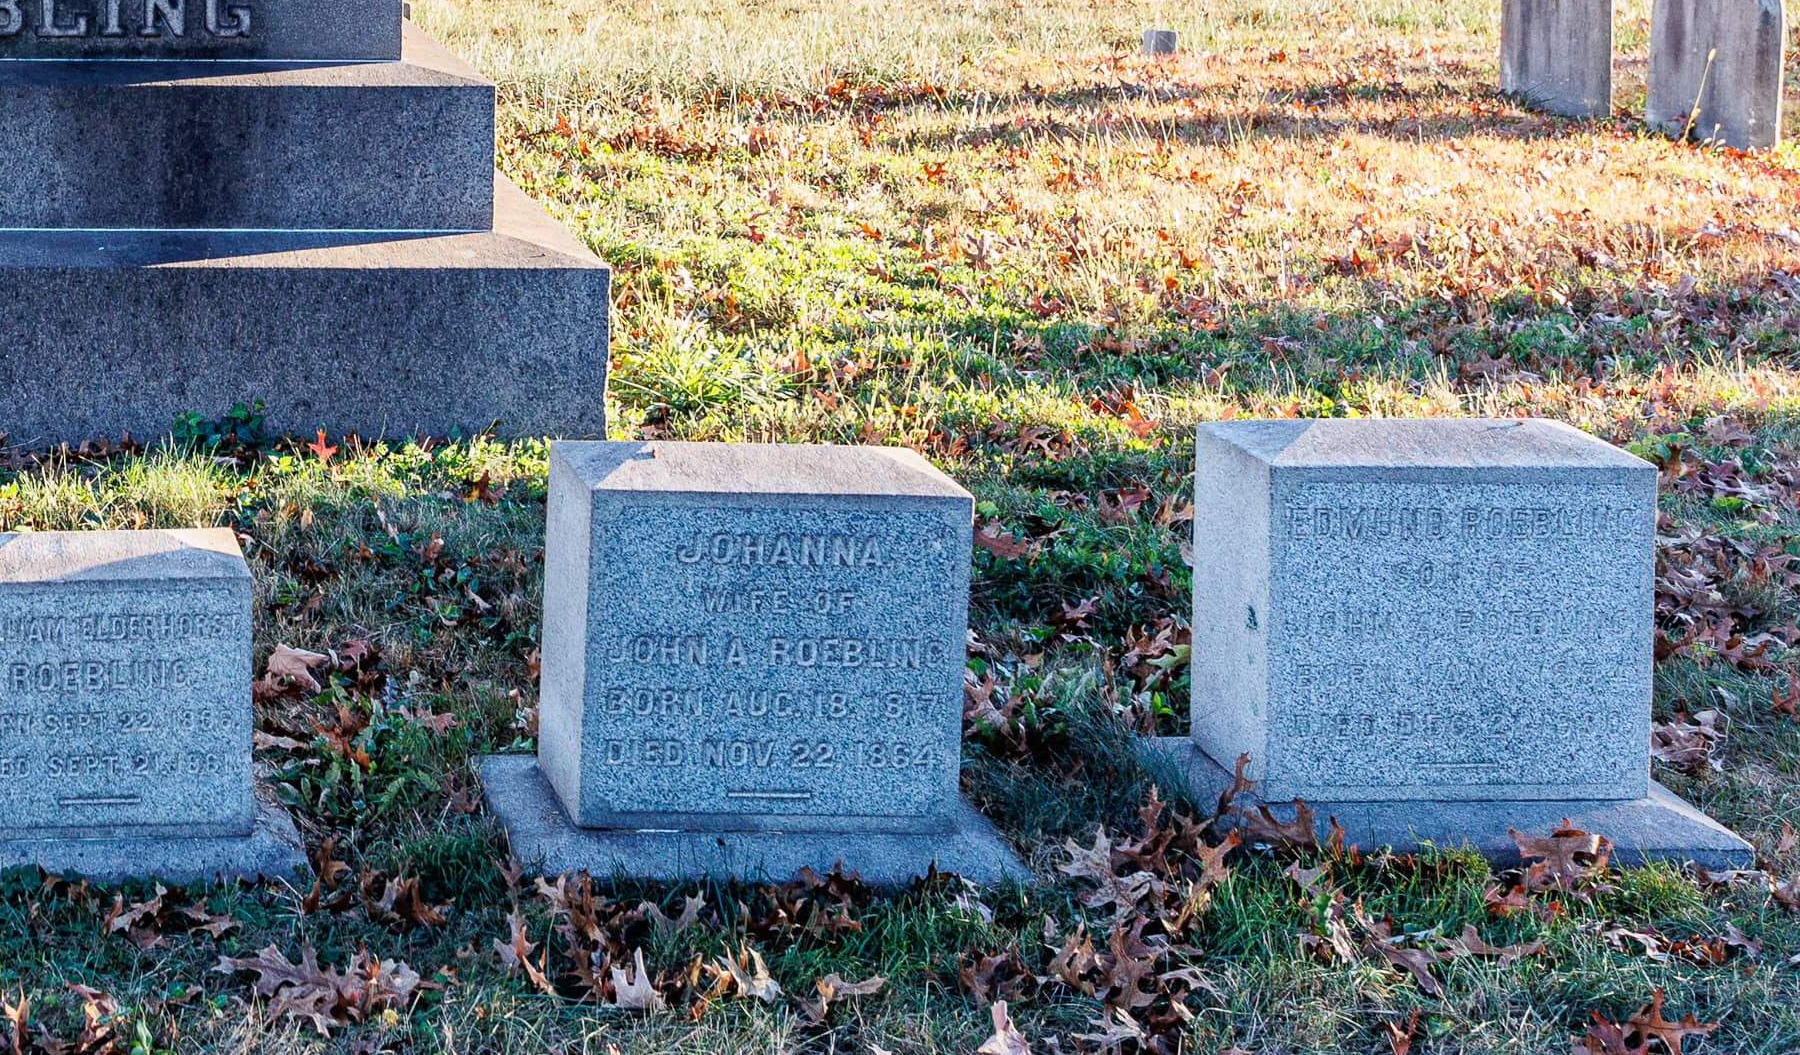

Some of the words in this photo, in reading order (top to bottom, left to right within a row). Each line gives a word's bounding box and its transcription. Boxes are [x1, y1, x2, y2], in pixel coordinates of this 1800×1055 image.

[1288, 506, 1452, 541] EDMUND
[675, 531, 886, 568] JOHANNA
[703, 588, 788, 614] WIFE
[812, 590, 857, 614] OF
[606, 634, 709, 667] JOHN
[768, 636, 948, 670] ROEBLING
[10, 659, 190, 693] ROEBLING
[603, 688, 703, 717] BORN
[604, 739, 685, 768] DIED
